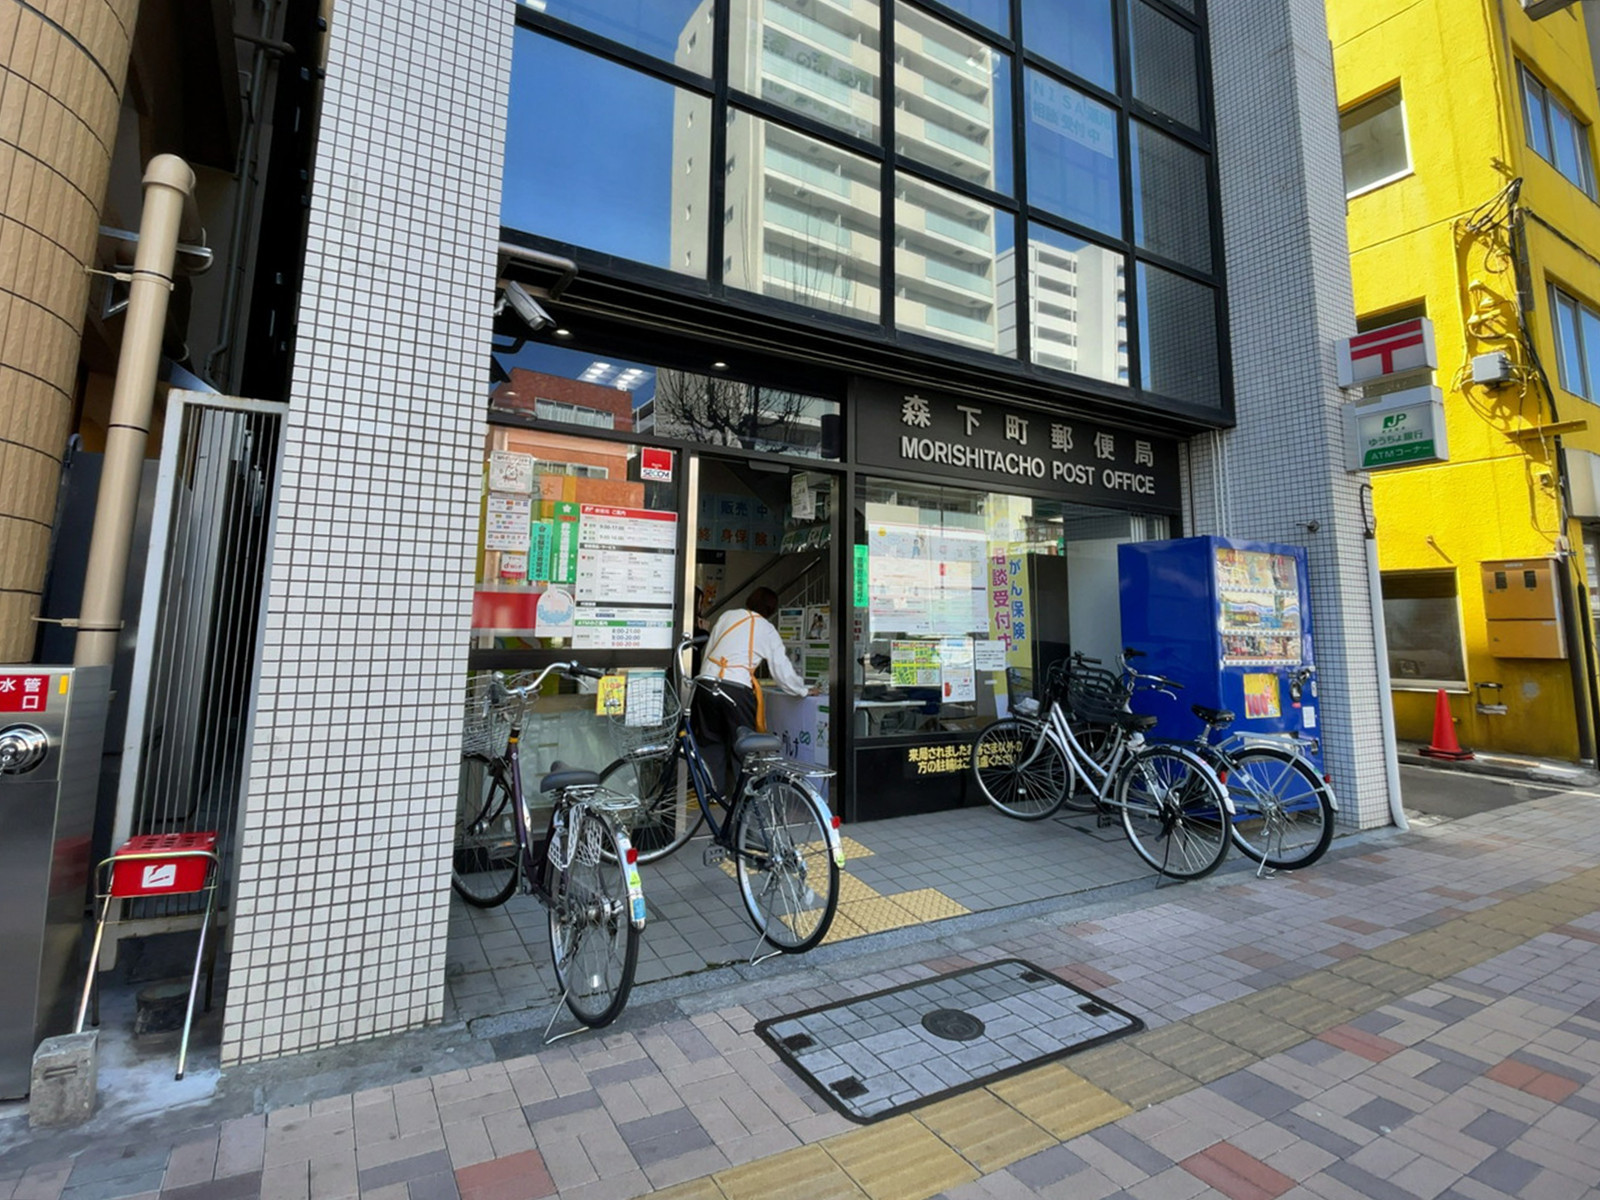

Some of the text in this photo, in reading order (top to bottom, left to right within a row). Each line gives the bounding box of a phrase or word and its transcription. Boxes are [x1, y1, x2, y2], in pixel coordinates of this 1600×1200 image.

[902, 394, 1153, 467] 森下町郵便局
[1368, 430, 1423, 447] ゆうちょ銀行
[901, 435, 1155, 495] MORISHITACHO POST OFFICE
[1371, 445, 1431, 460] ATMコーナー
[1009, 558, 1026, 641] がん保険
[22, 695, 39, 709] 口
